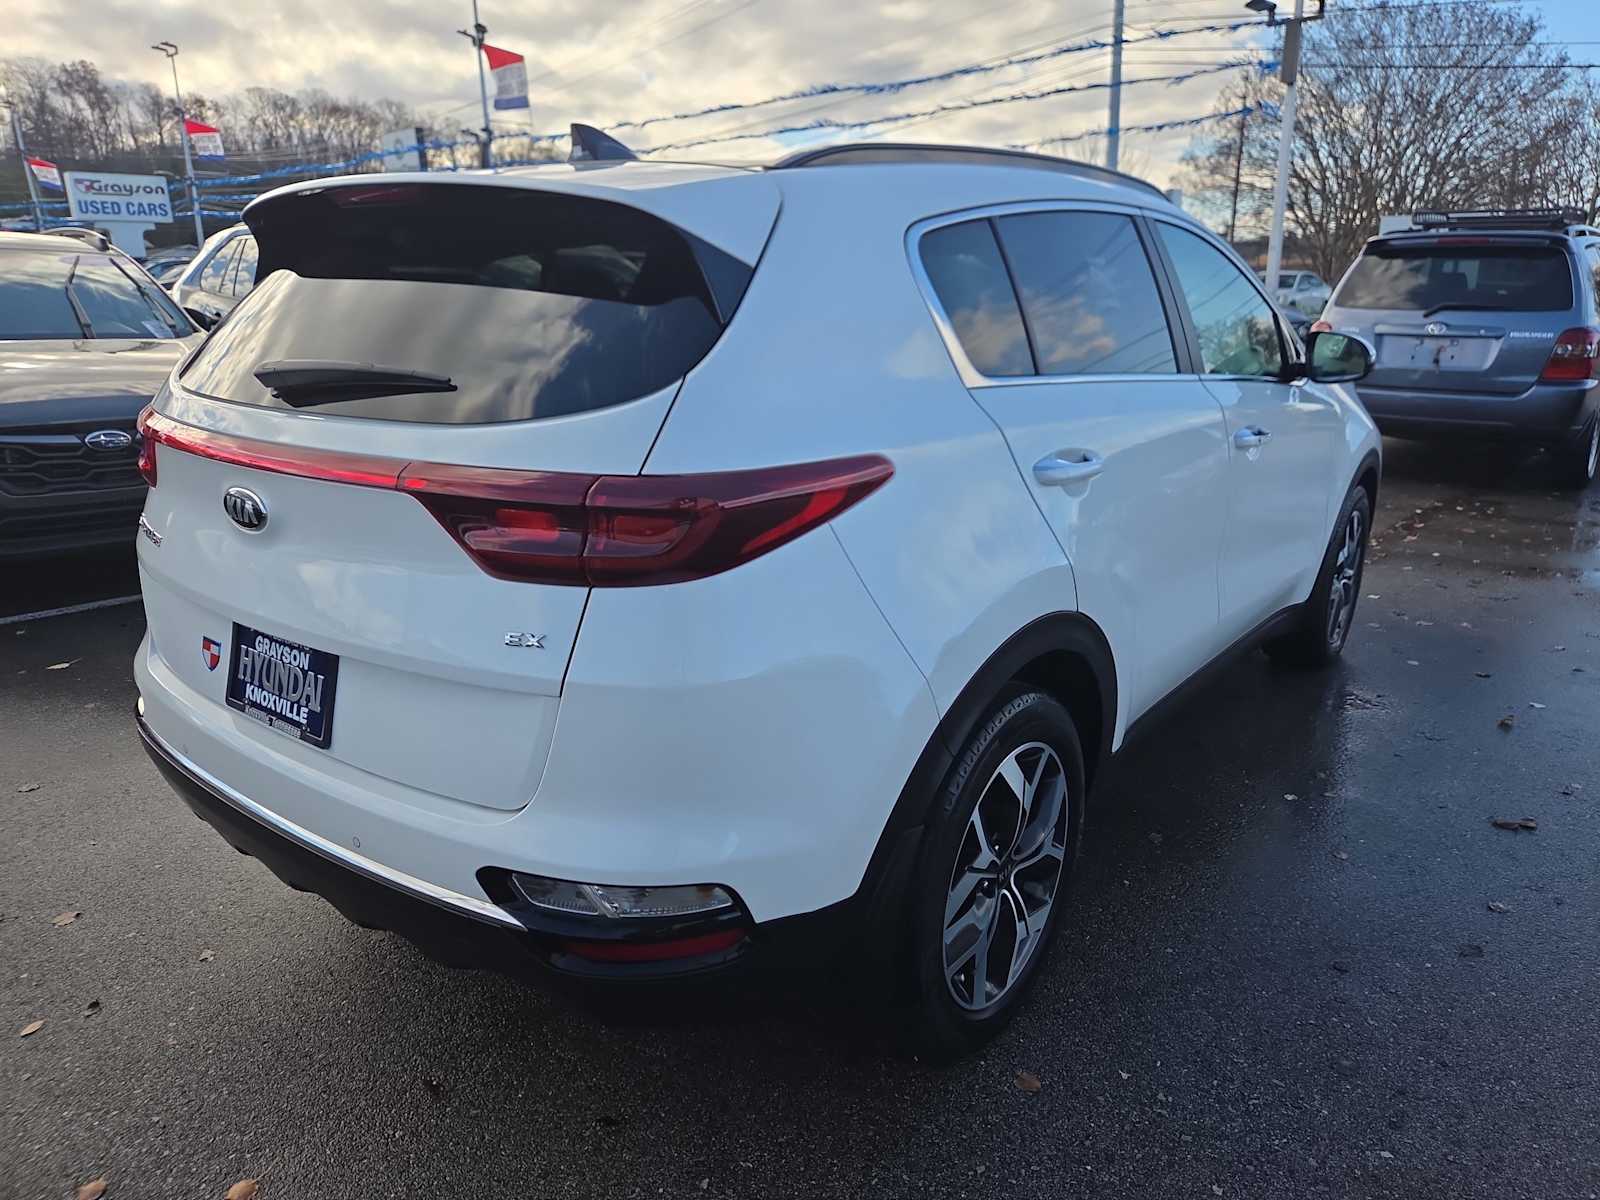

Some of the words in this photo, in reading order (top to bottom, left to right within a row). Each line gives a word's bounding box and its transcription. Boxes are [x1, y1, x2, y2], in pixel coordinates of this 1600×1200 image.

[89, 180, 165, 196] Grayson
[78, 200, 121, 215] USED
[126, 202, 169, 217] CARS
[225, 494, 259, 525] KIA
[255, 635, 310, 670] GRAYSON
[504, 632, 546, 648] EX
[238, 644, 324, 713] HYUNDAI
[245, 683, 309, 724] KNOXVILLE
